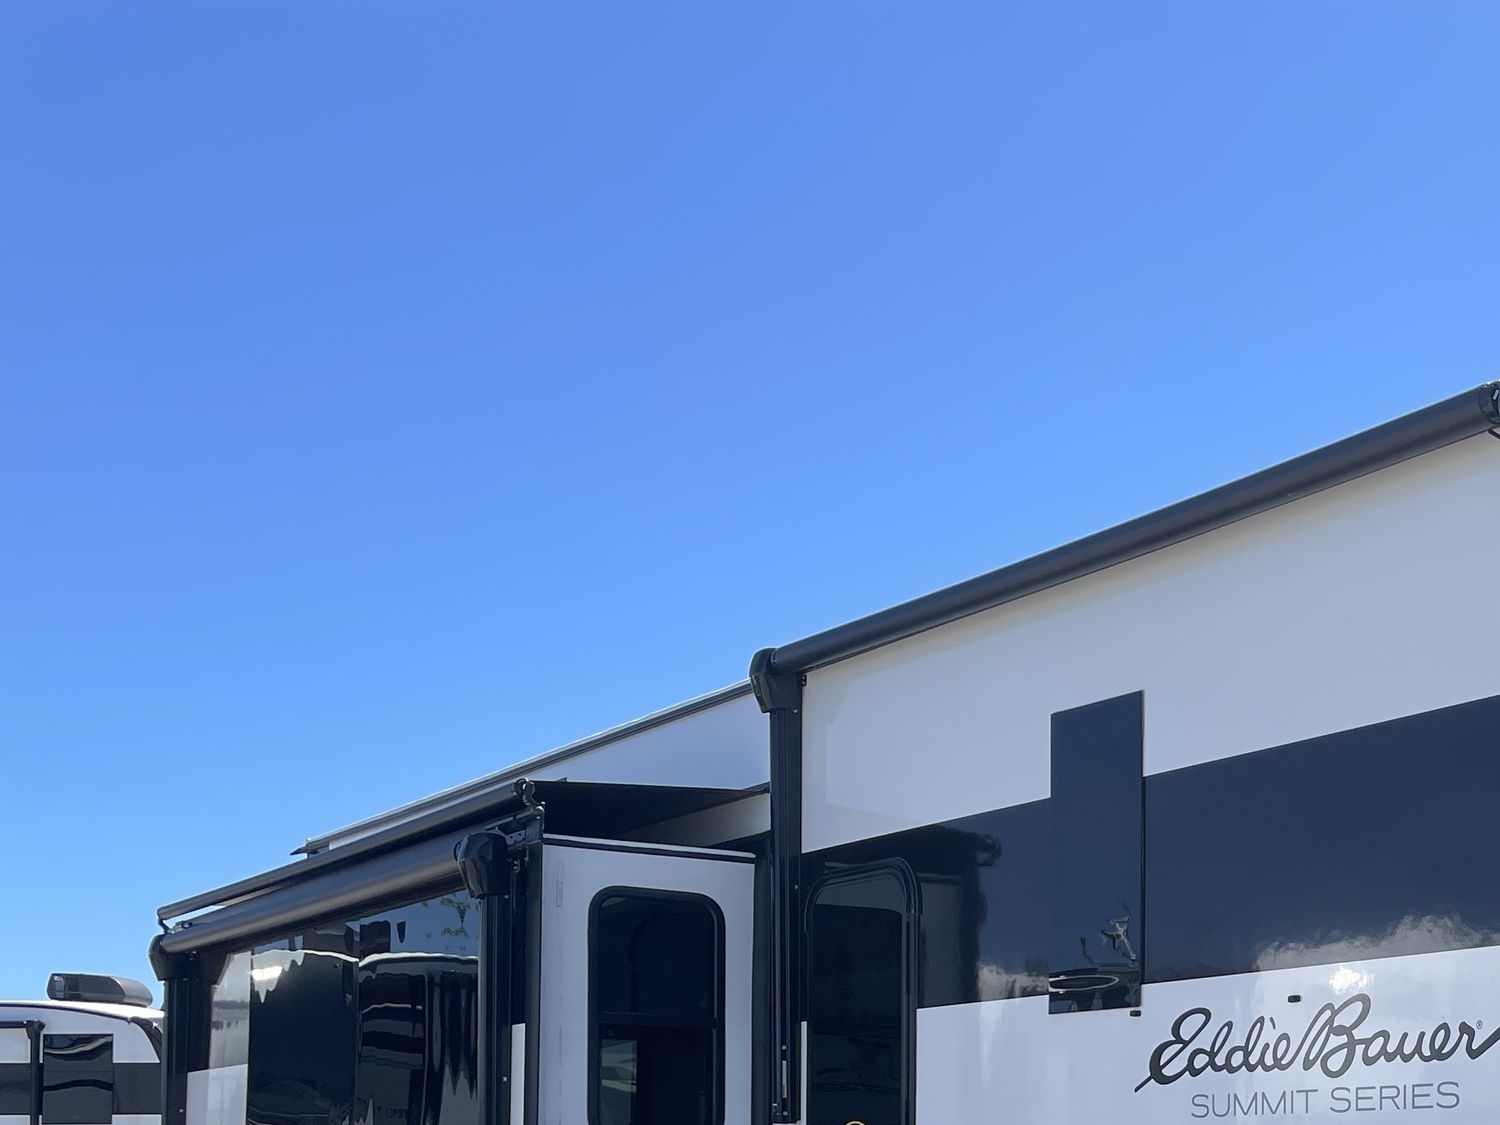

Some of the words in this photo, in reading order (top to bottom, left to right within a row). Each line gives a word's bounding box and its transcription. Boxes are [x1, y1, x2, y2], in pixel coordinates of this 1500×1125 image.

[1134, 1007, 1303, 1093] Eddie
[1191, 1088, 1318, 1119] SUMMIT
[1330, 1081, 1460, 1114] SERIES
